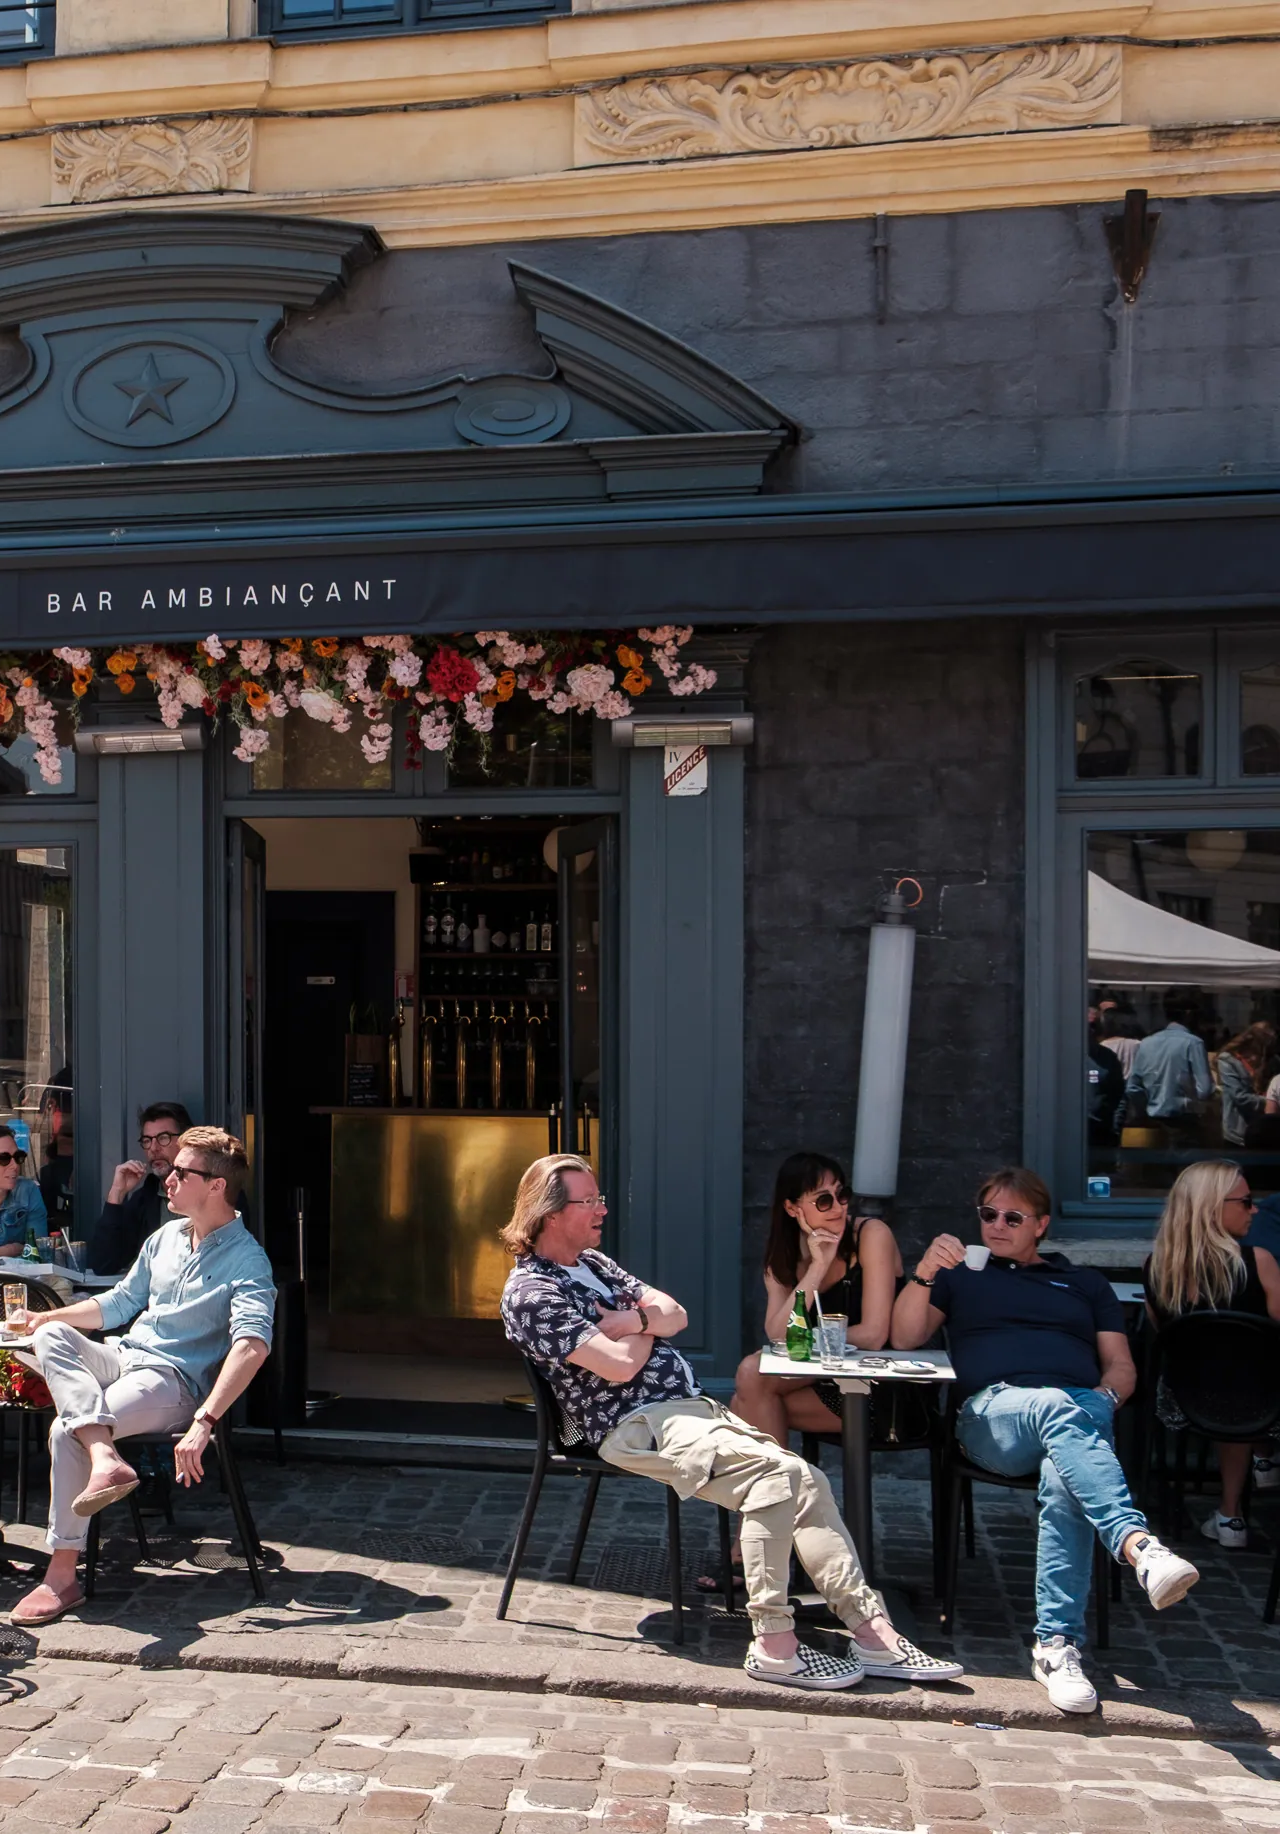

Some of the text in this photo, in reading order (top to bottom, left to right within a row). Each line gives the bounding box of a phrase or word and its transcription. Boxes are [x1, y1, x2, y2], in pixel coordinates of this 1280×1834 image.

[47, 590, 114, 614] BAR
[141, 579, 397, 609] AMBIANÇANT
[667, 746, 705, 790] LICENCE
[669, 751, 681, 763] IV
